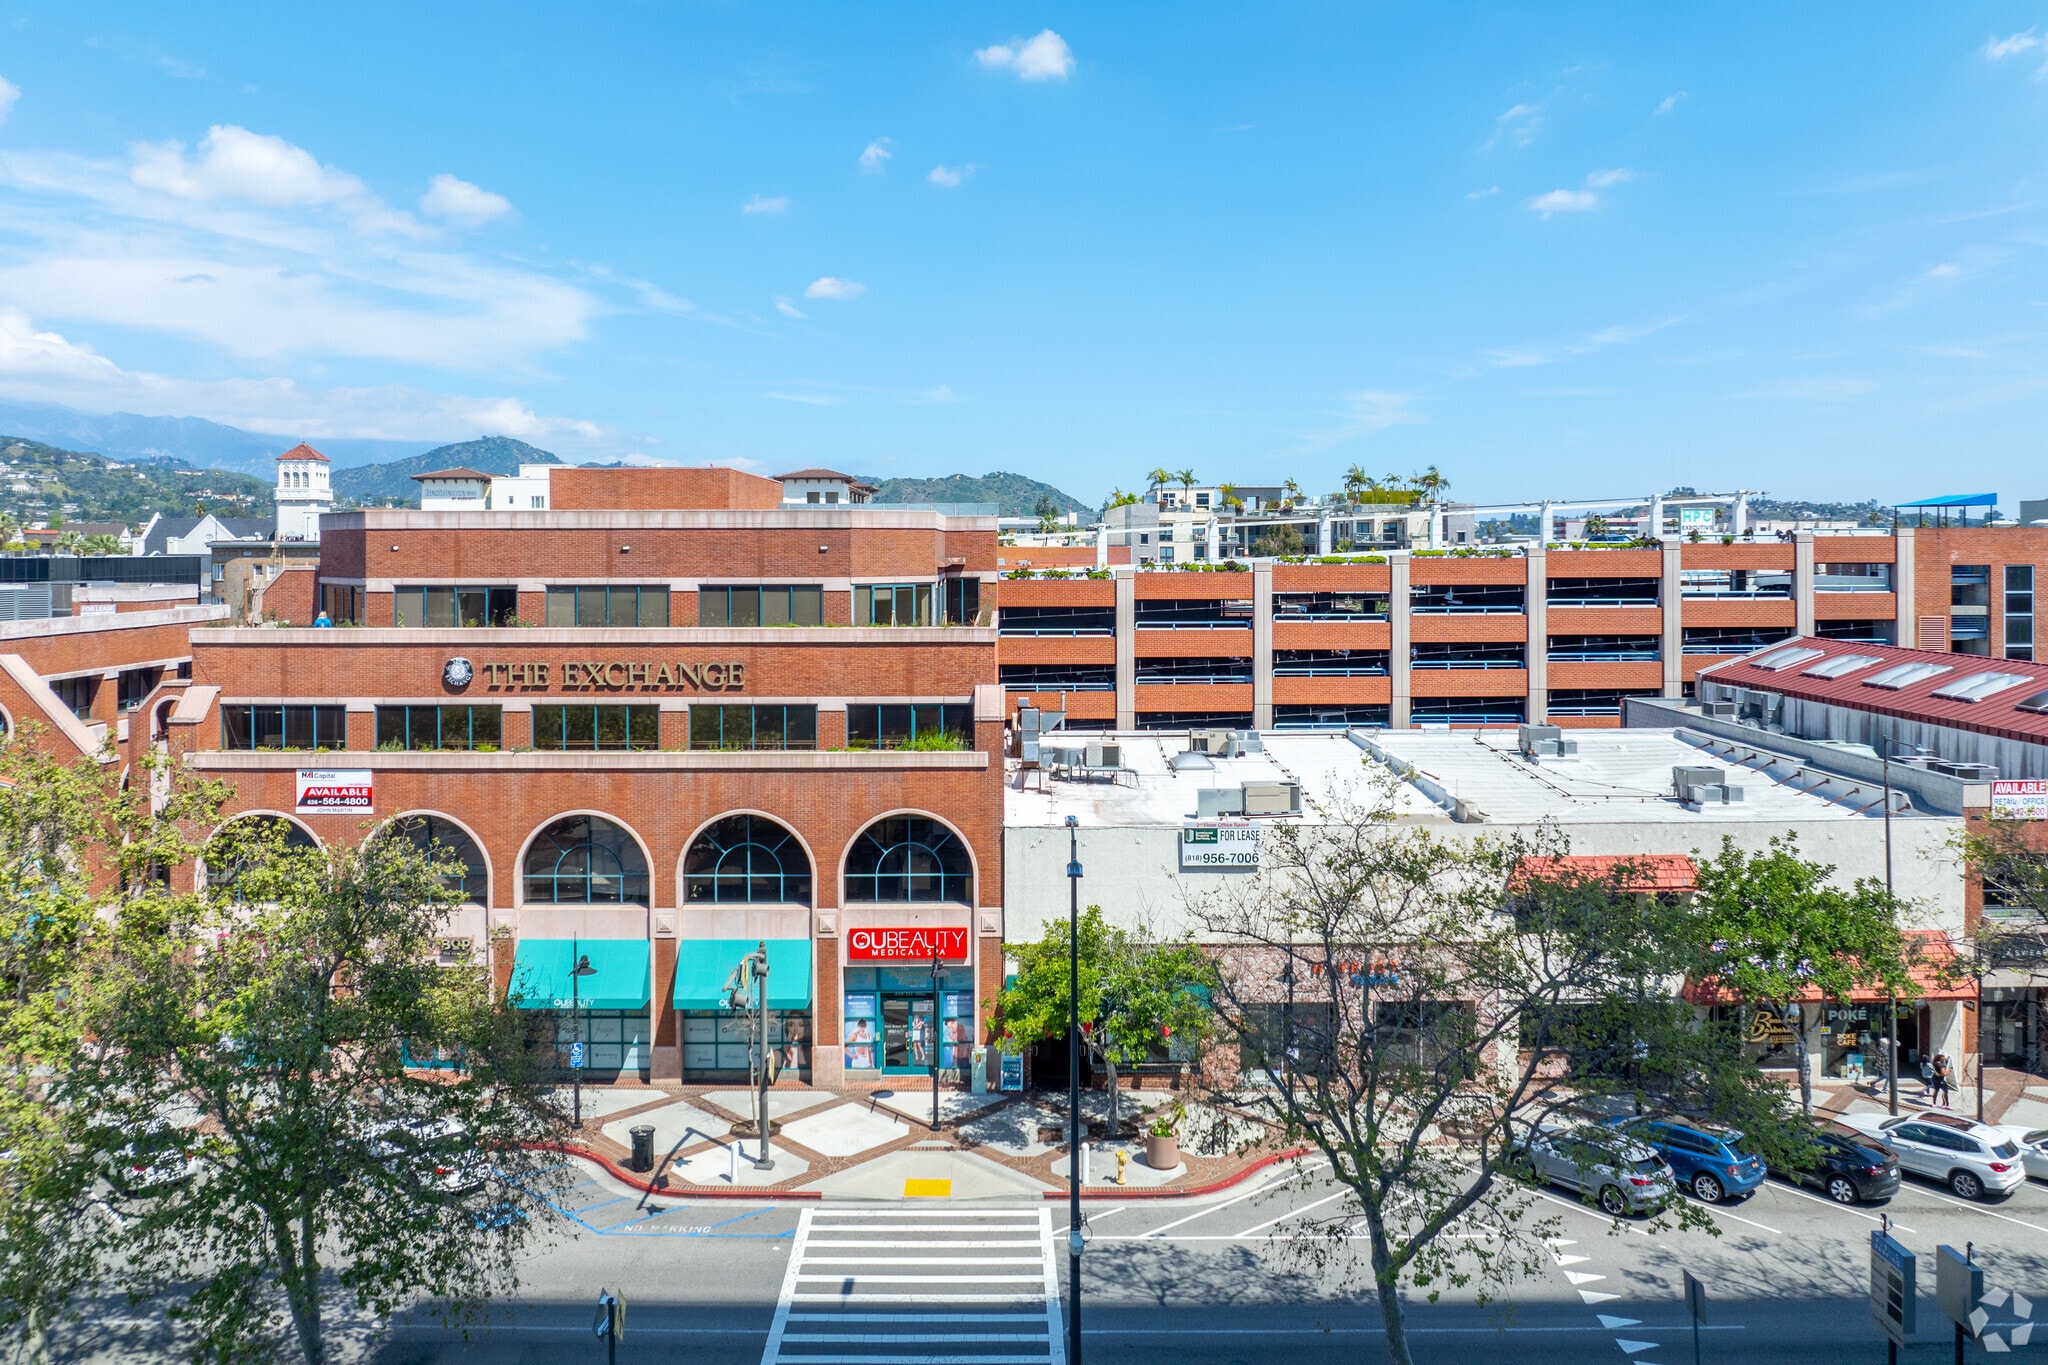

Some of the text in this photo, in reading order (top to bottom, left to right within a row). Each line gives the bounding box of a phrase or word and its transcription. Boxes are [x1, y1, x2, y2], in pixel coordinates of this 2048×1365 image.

[1683, 510, 1712, 522] HPC
[485, 661, 746, 687] THE EXCHANGE
[314, 772, 336, 780] Capital
[307, 787, 369, 797] AVAILABLE
[1994, 782, 2046, 794] AVAILABLE
[1994, 797, 2017, 805] RETAIL
[2022, 797, 2045, 805] OFFICE
[1220, 829, 1235, 841] FOR
[1237, 829, 1260, 841] LEASE
[1184, 852, 1260, 864] (818) 956-7006
[871, 948, 946, 956] MEDICAL SPA
[1828, 1007, 1867, 1020] POKÉ
